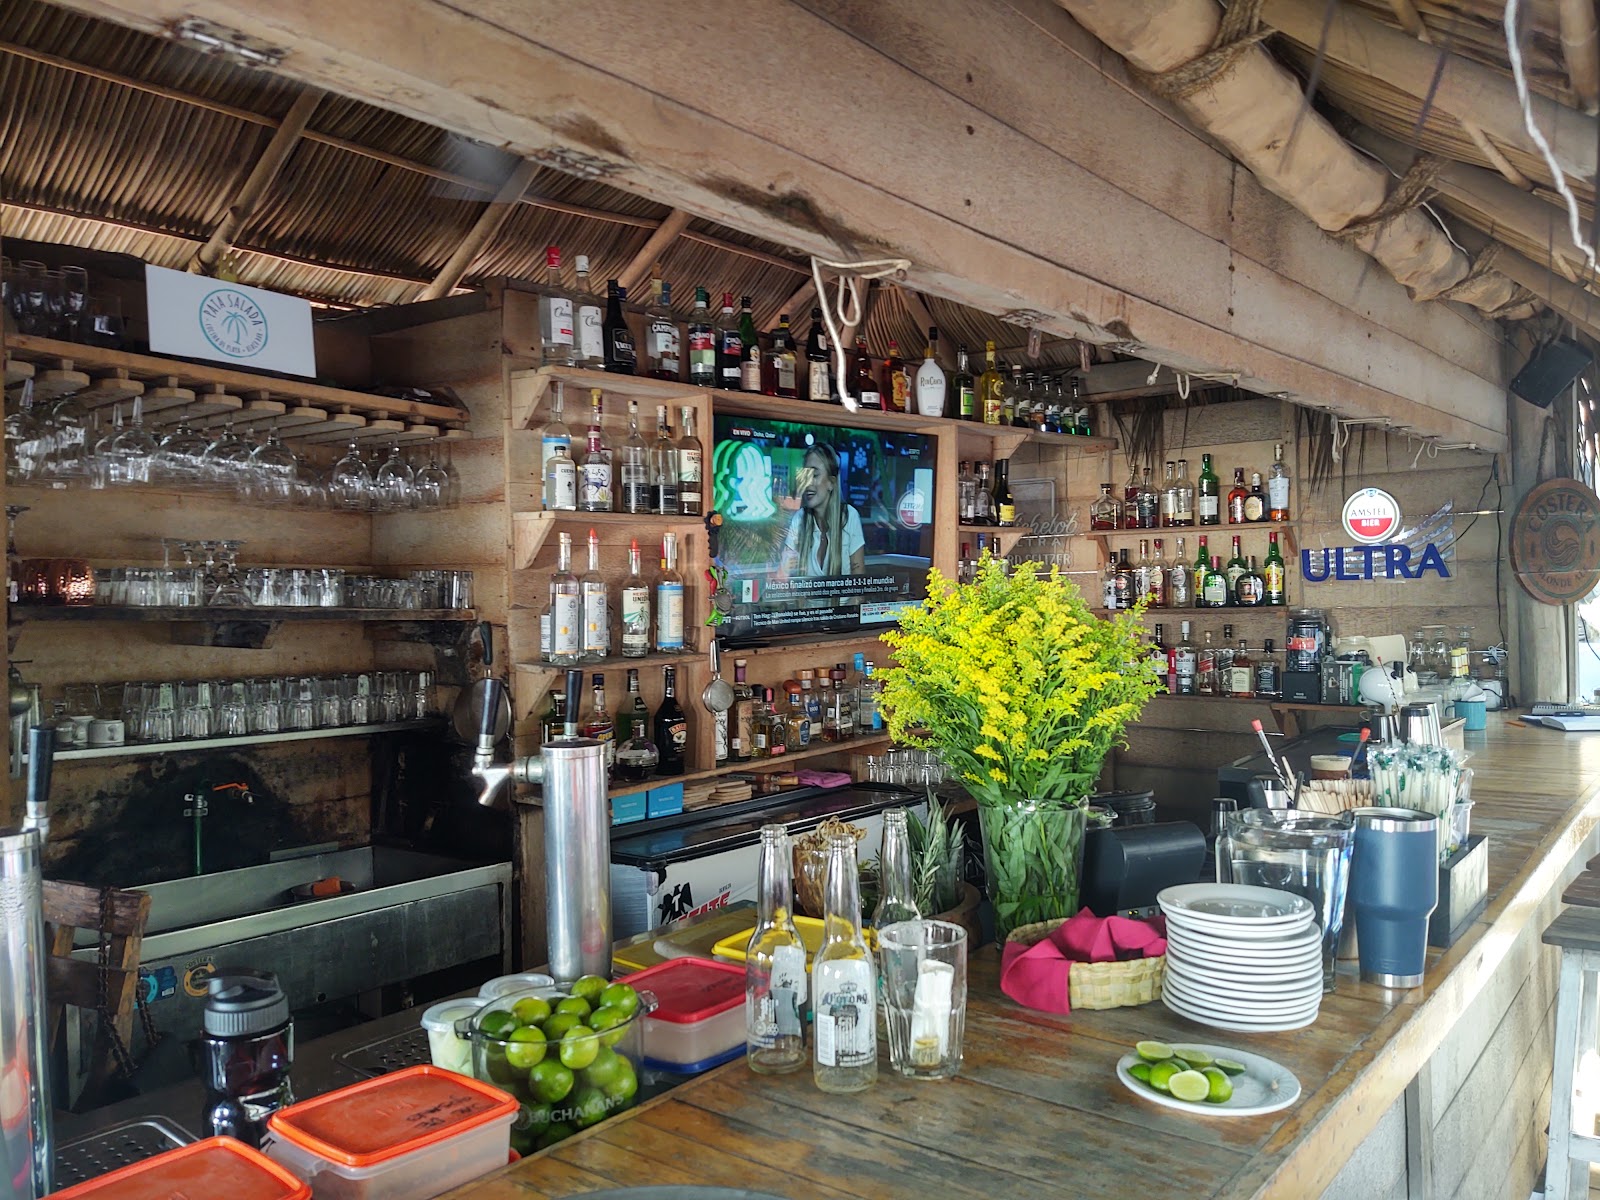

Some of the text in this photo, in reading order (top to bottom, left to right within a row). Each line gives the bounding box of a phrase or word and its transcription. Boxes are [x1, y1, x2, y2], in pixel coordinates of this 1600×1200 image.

[203, 294, 263, 326] PATA SALADA
[1351, 507, 1387, 516] AMSTEL
[1529, 494, 1594, 533] COSTERA
[1361, 518, 1380, 527] BIER
[1017, 538, 1061, 547] LTRA
[1007, 554, 1022, 565] RD
[1301, 543, 1451, 582] ULTRA
[765, 575, 895, 590] México finalizó con marca de 1-1-1 el mundial
[185, 955, 213, 969] COSTERA
